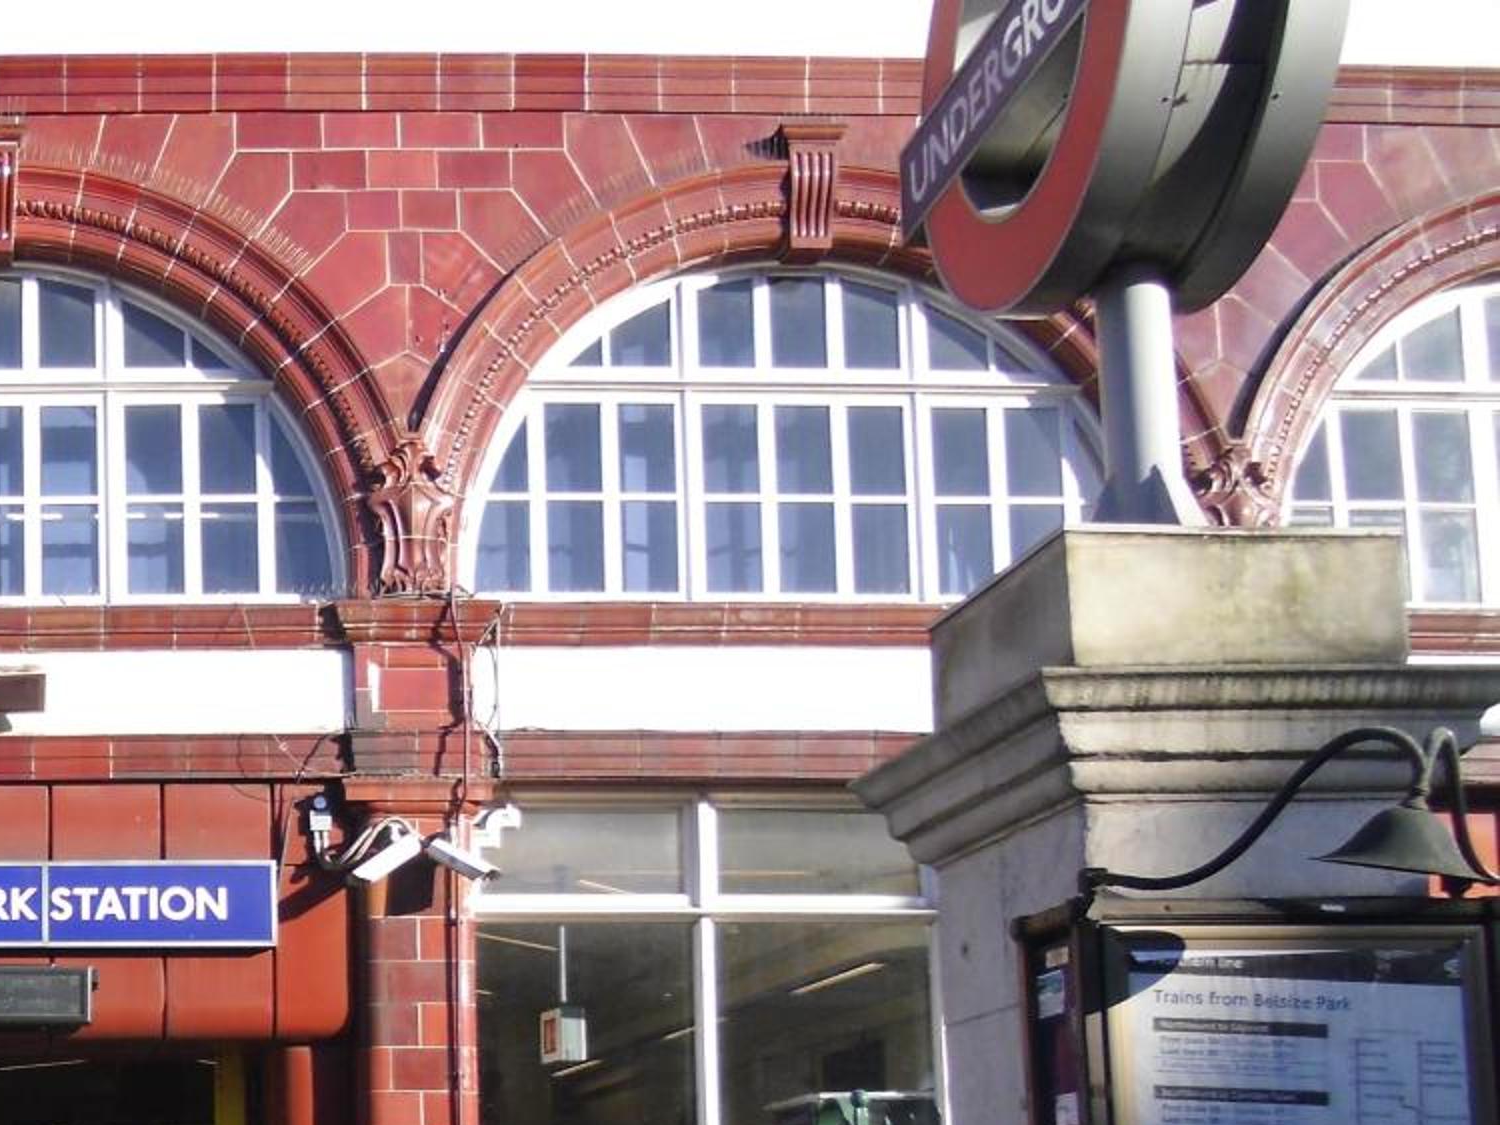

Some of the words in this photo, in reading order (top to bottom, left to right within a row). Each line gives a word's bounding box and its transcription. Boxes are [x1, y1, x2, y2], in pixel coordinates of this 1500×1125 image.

[49, 886, 229, 923] STATION
[1153, 989, 1203, 1005] Trains
[1209, 991, 1249, 1007] from
[1253, 993, 1313, 1009] Belsize
[1316, 995, 1351, 1010] Park
